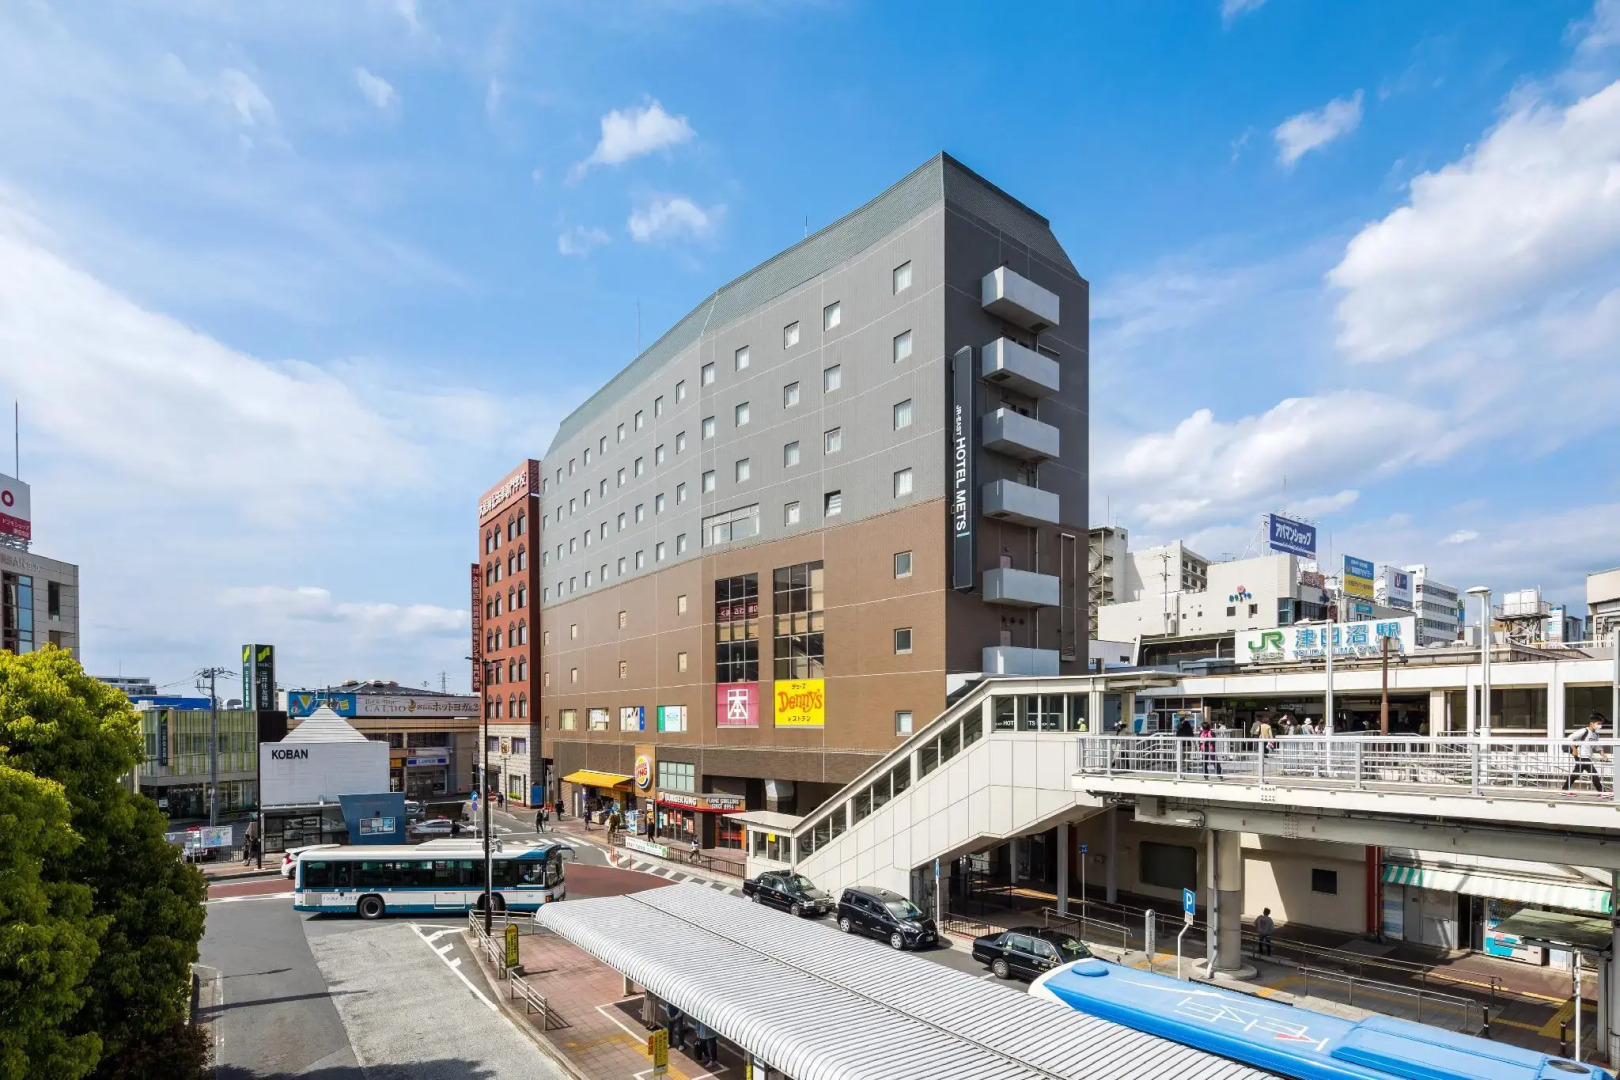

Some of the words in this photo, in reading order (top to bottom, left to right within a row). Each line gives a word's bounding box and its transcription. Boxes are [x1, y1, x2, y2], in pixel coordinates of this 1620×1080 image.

[956, 437, 966, 489] HOTEL
[956, 489, 967, 531] METS
[1275, 523, 1312, 546] アパマンショップ
[1248, 630, 1284, 651] JR
[1293, 645, 1357, 659] TSUDAUMA
[778, 688, 823, 713] Denny's
[272, 749, 309, 760] KOBAN
[664, 793, 684, 804] BURGER
[683, 796, 698, 806] KING
[1186, 892, 1193, 910] P
[1174, 997, 1329, 1051] KEISEI
